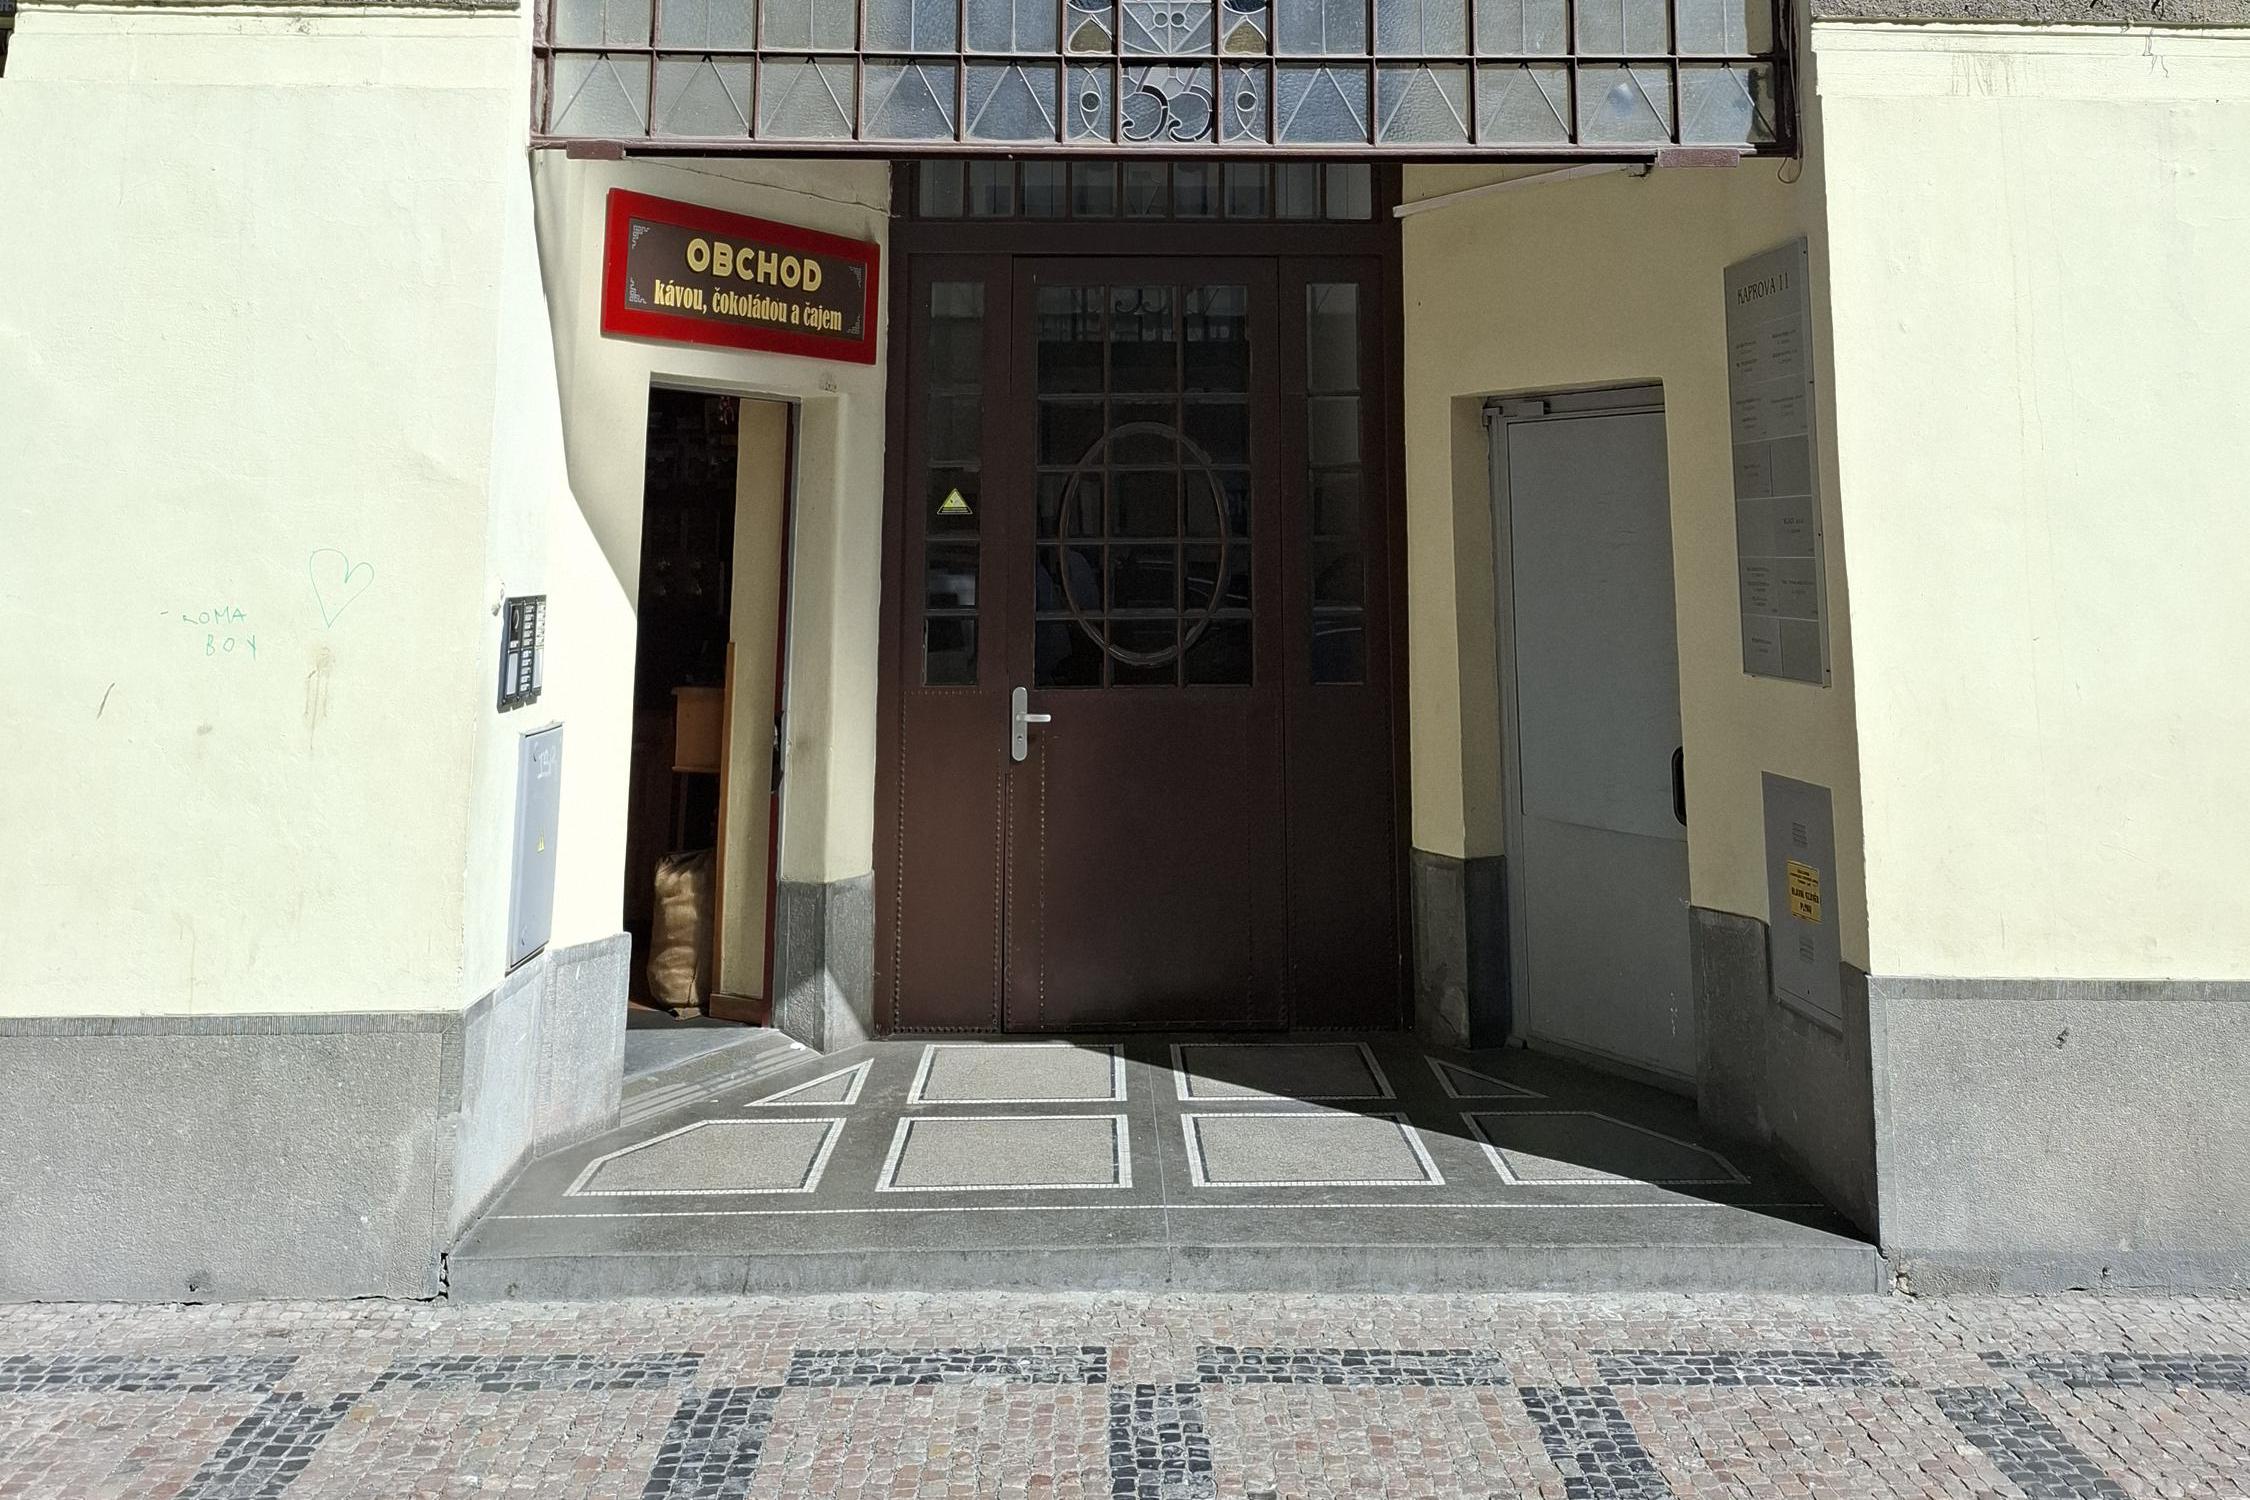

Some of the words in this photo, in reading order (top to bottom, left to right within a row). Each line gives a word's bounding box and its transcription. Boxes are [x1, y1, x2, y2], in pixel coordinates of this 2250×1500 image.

[686, 238, 823, 292] OBCHOD
[654, 279, 708, 315] kávou,
[712, 286, 788, 323] čokoládou
[791, 304, 800, 325] a
[803, 302, 842, 331] čajem
[1737, 277, 1776, 306] KAPROVA
[1778, 271, 1790, 291] 11
[206, 633, 257, 661] BOY
